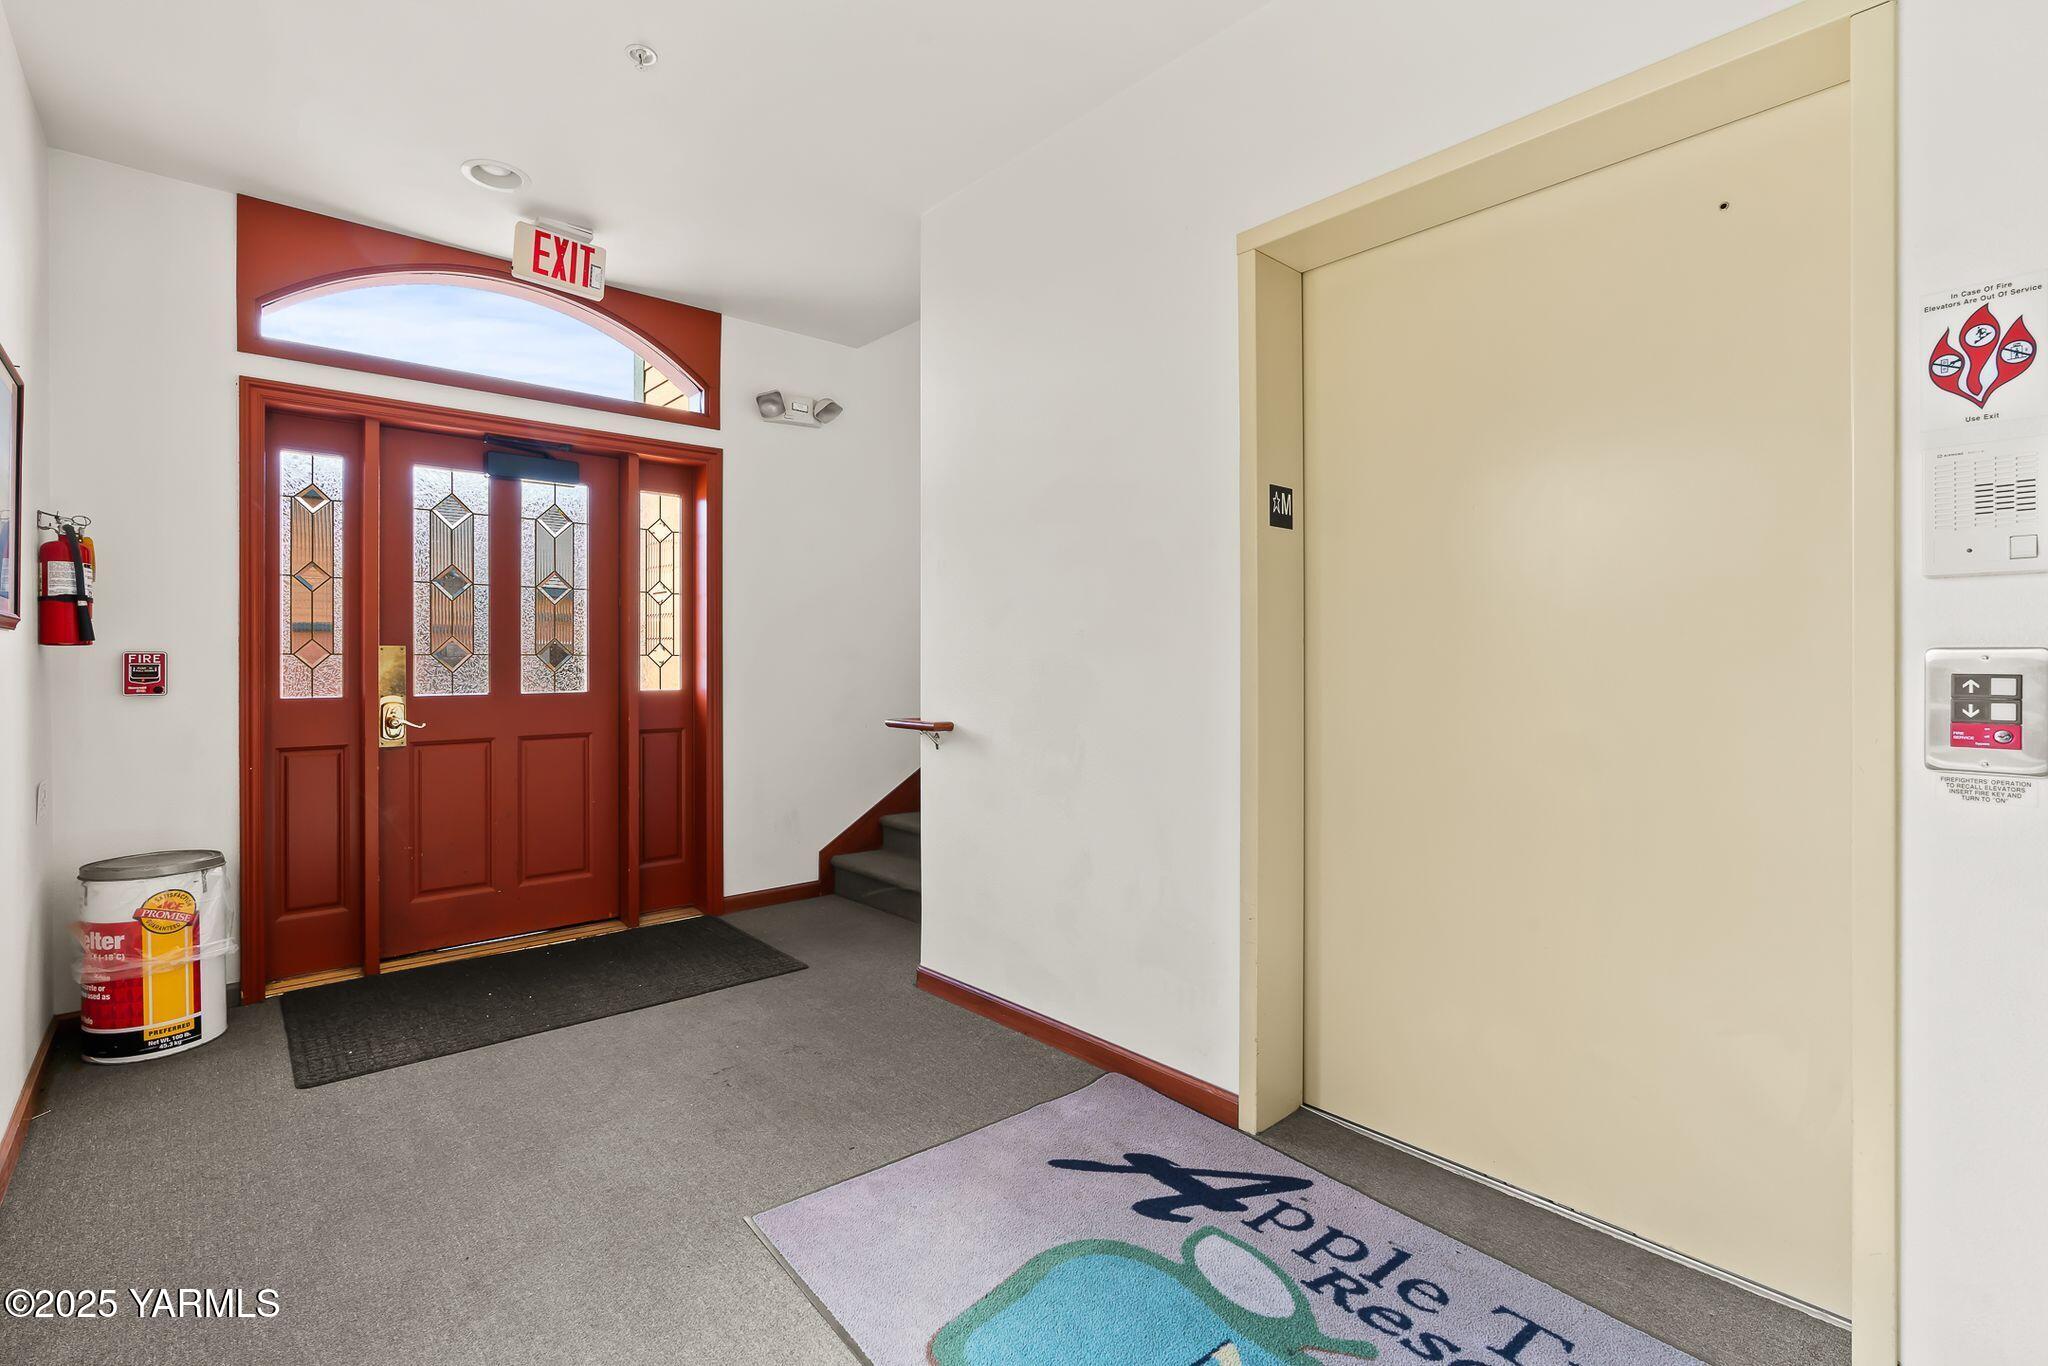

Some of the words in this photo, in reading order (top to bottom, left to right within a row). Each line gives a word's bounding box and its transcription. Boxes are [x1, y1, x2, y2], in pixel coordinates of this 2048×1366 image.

[532, 229, 596, 288] EXIT
[1961, 289, 1981, 298] Case
[1983, 285, 1994, 293] Of
[1996, 281, 2013, 290] Fire
[1923, 300, 1961, 313] Elevators
[1963, 296, 1978, 305] Are
[1980, 293, 1995, 301] Out
[1997, 290, 2008, 298] Of
[2010, 284, 2043, 296] Service
[1965, 415, 1981, 423] Use
[1983, 412, 2000, 420] Exit
[1281, 492, 1292, 516] M
[128, 654, 161, 663] FIRE
[1984, 785, 2026, 793] ELEVATORS
[1990, 779, 2032, 788] OPERATION
[141, 909, 192, 922] PROMISE
[148, 1021, 191, 1037] PREFERRED
[148, 1039, 160, 1047] Net
[1047, 1152, 1450, 1314] Apple
[1486, 1304, 1582, 1366] T
